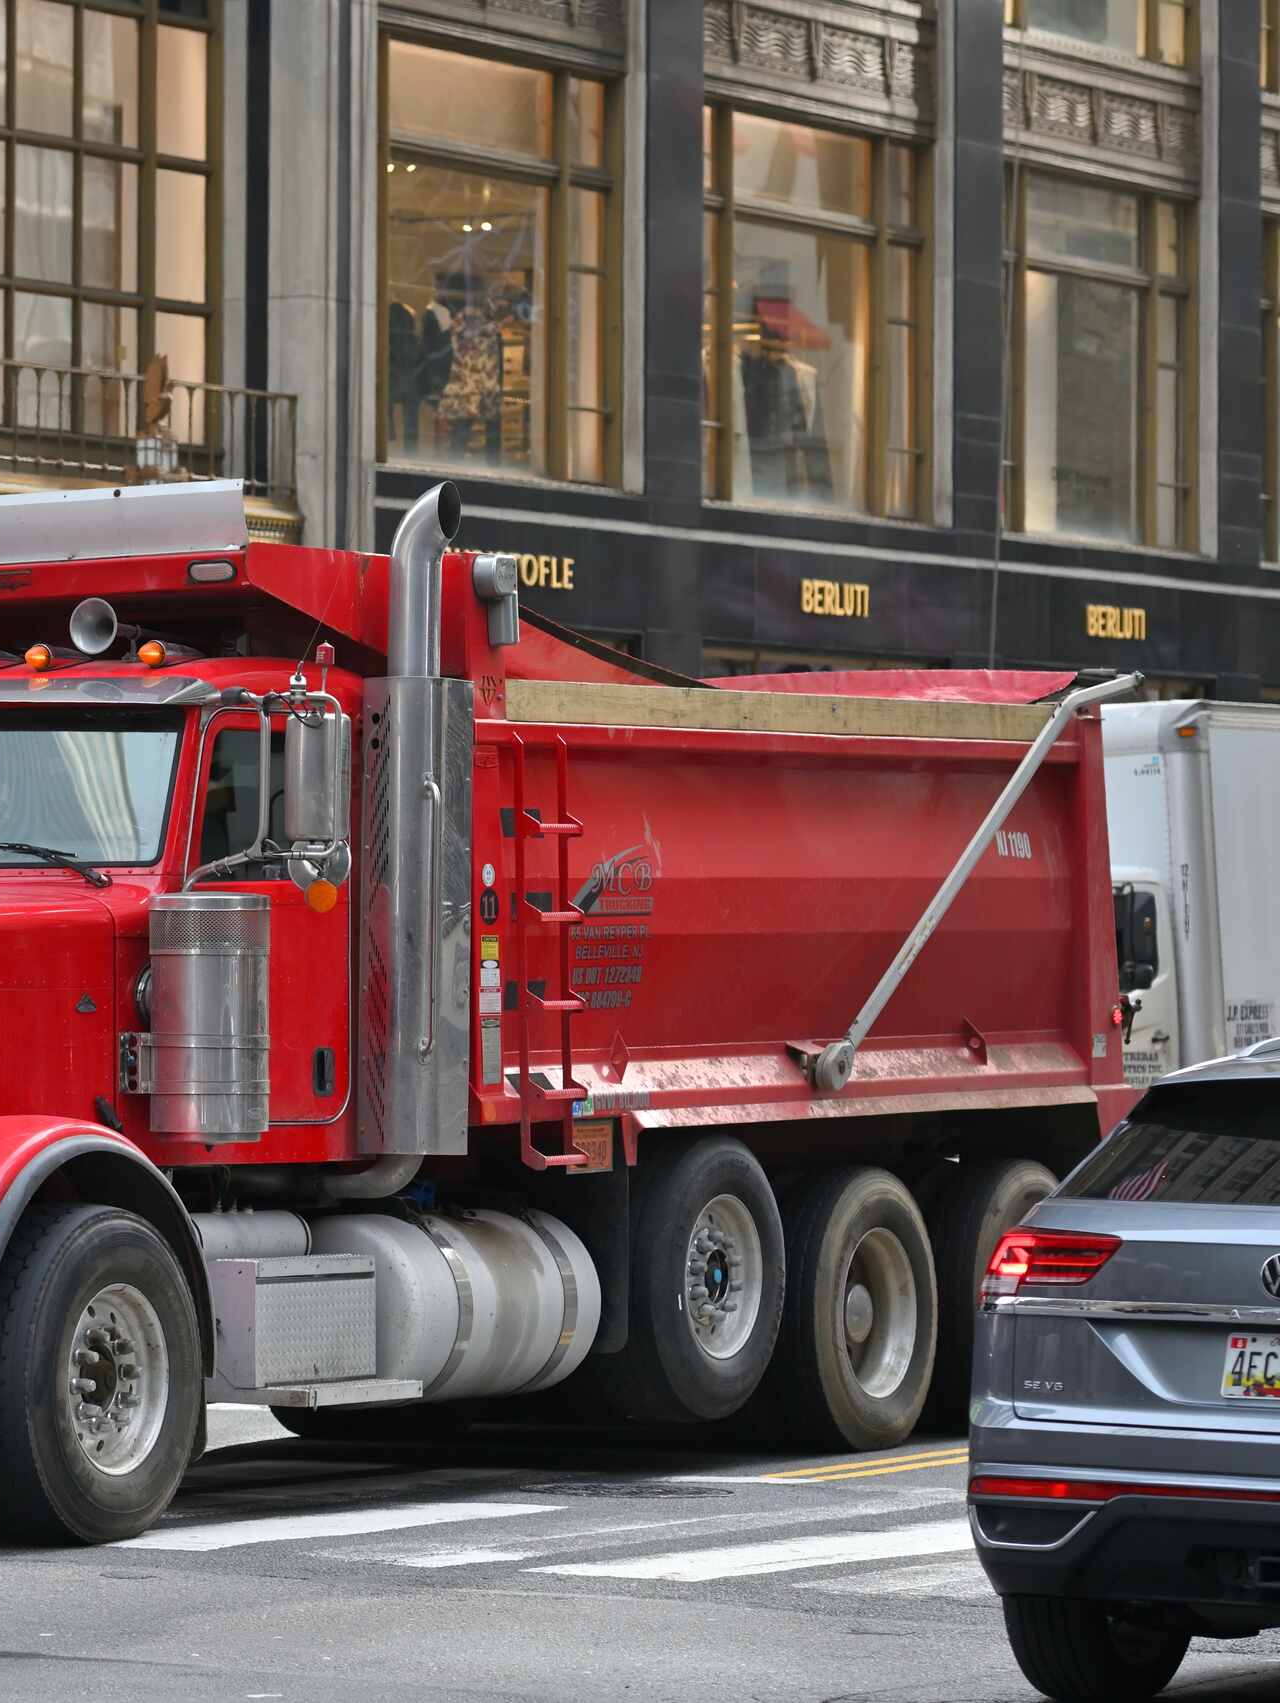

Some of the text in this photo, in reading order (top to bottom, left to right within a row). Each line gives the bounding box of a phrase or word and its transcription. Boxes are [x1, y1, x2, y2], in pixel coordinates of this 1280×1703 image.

[801, 579, 869, 618] BERLUTI
[1086, 603, 1147, 641] BERLUTI
[1008, 831, 1032, 859] 1190
[591, 863, 652, 896] MCB
[482, 896, 497, 919] 11
[1023, 1380, 1064, 1391] SE V6
